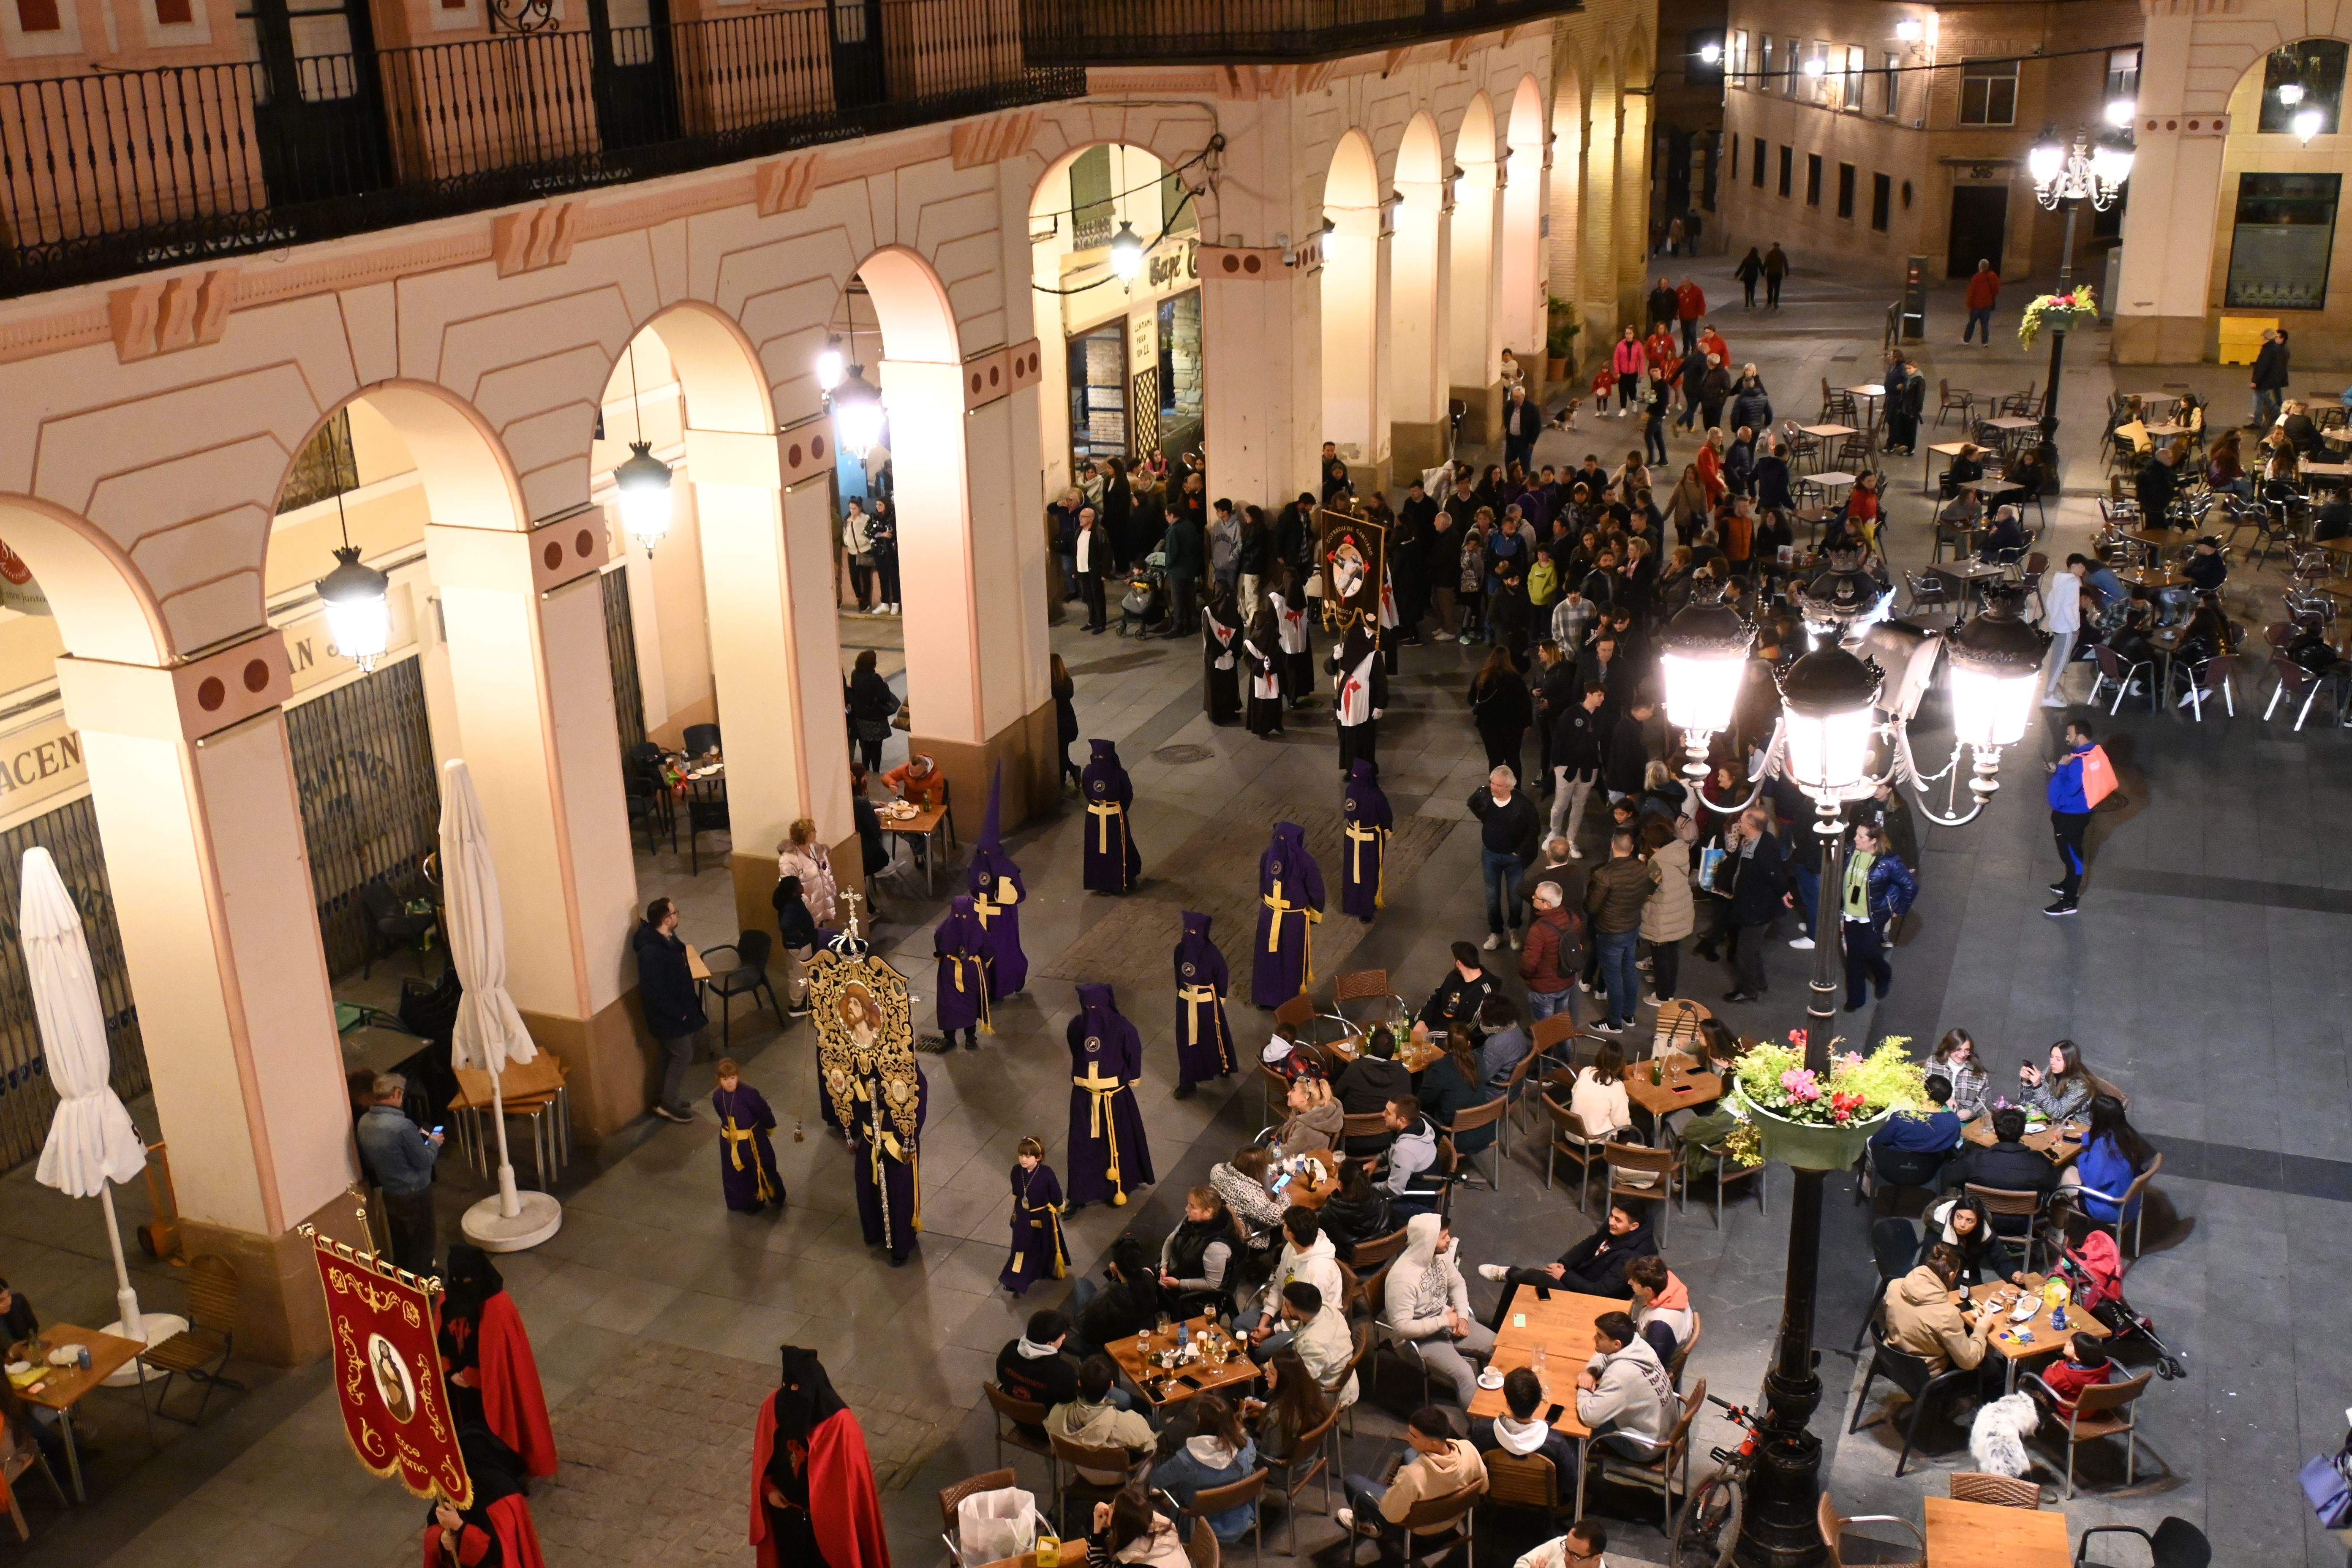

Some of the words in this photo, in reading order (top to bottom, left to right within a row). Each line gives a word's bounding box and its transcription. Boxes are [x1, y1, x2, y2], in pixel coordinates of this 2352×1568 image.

[1356, 528, 1373, 555] SANTIAGO
[395, 1432, 420, 1457] Ecce
[398, 1447, 428, 1474] Homo
